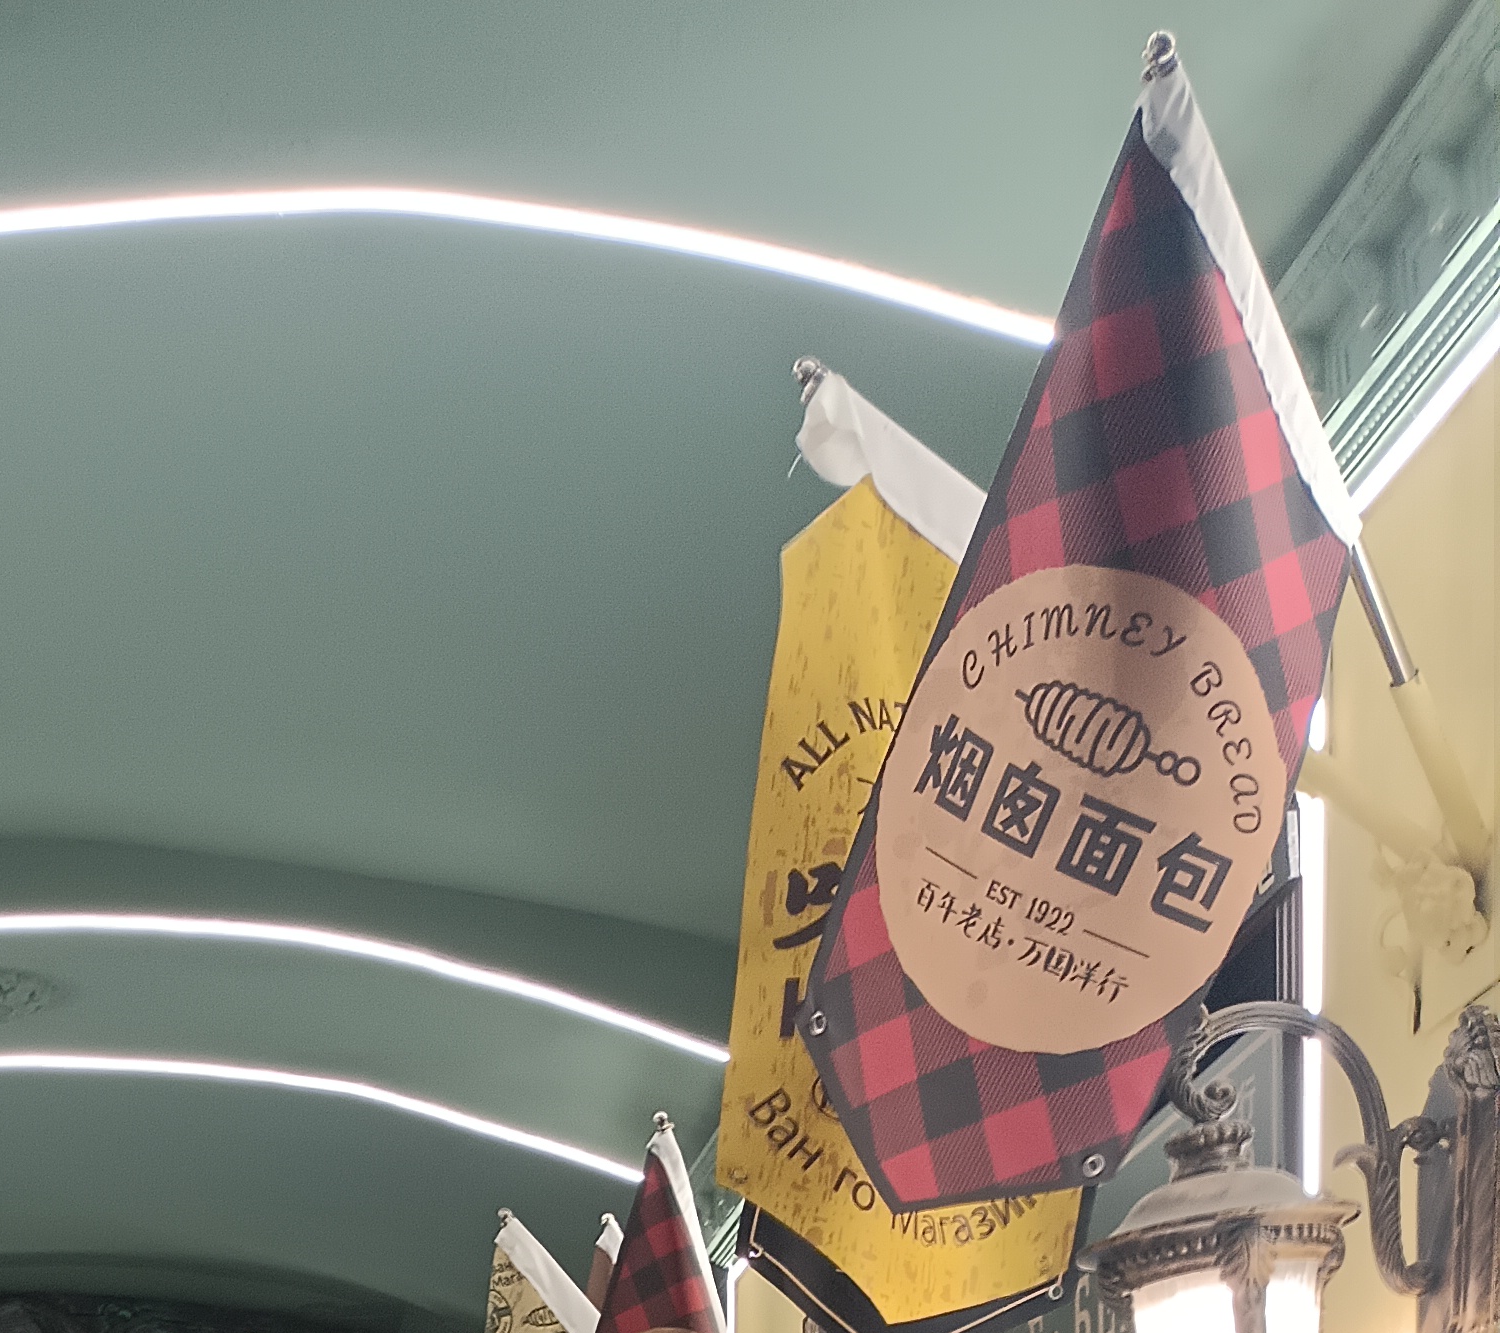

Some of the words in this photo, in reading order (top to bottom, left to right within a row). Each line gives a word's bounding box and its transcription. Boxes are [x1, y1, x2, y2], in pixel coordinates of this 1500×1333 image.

[780, 720, 851, 792] ALL
[962, 603, 1187, 690] CHIMNEY
[1190, 660, 1263, 835] BREAD
[913, 713, 1234, 934] 烟囱面包
[984, 879, 1024, 911] EST
[1025, 896, 1078, 938] 1922
